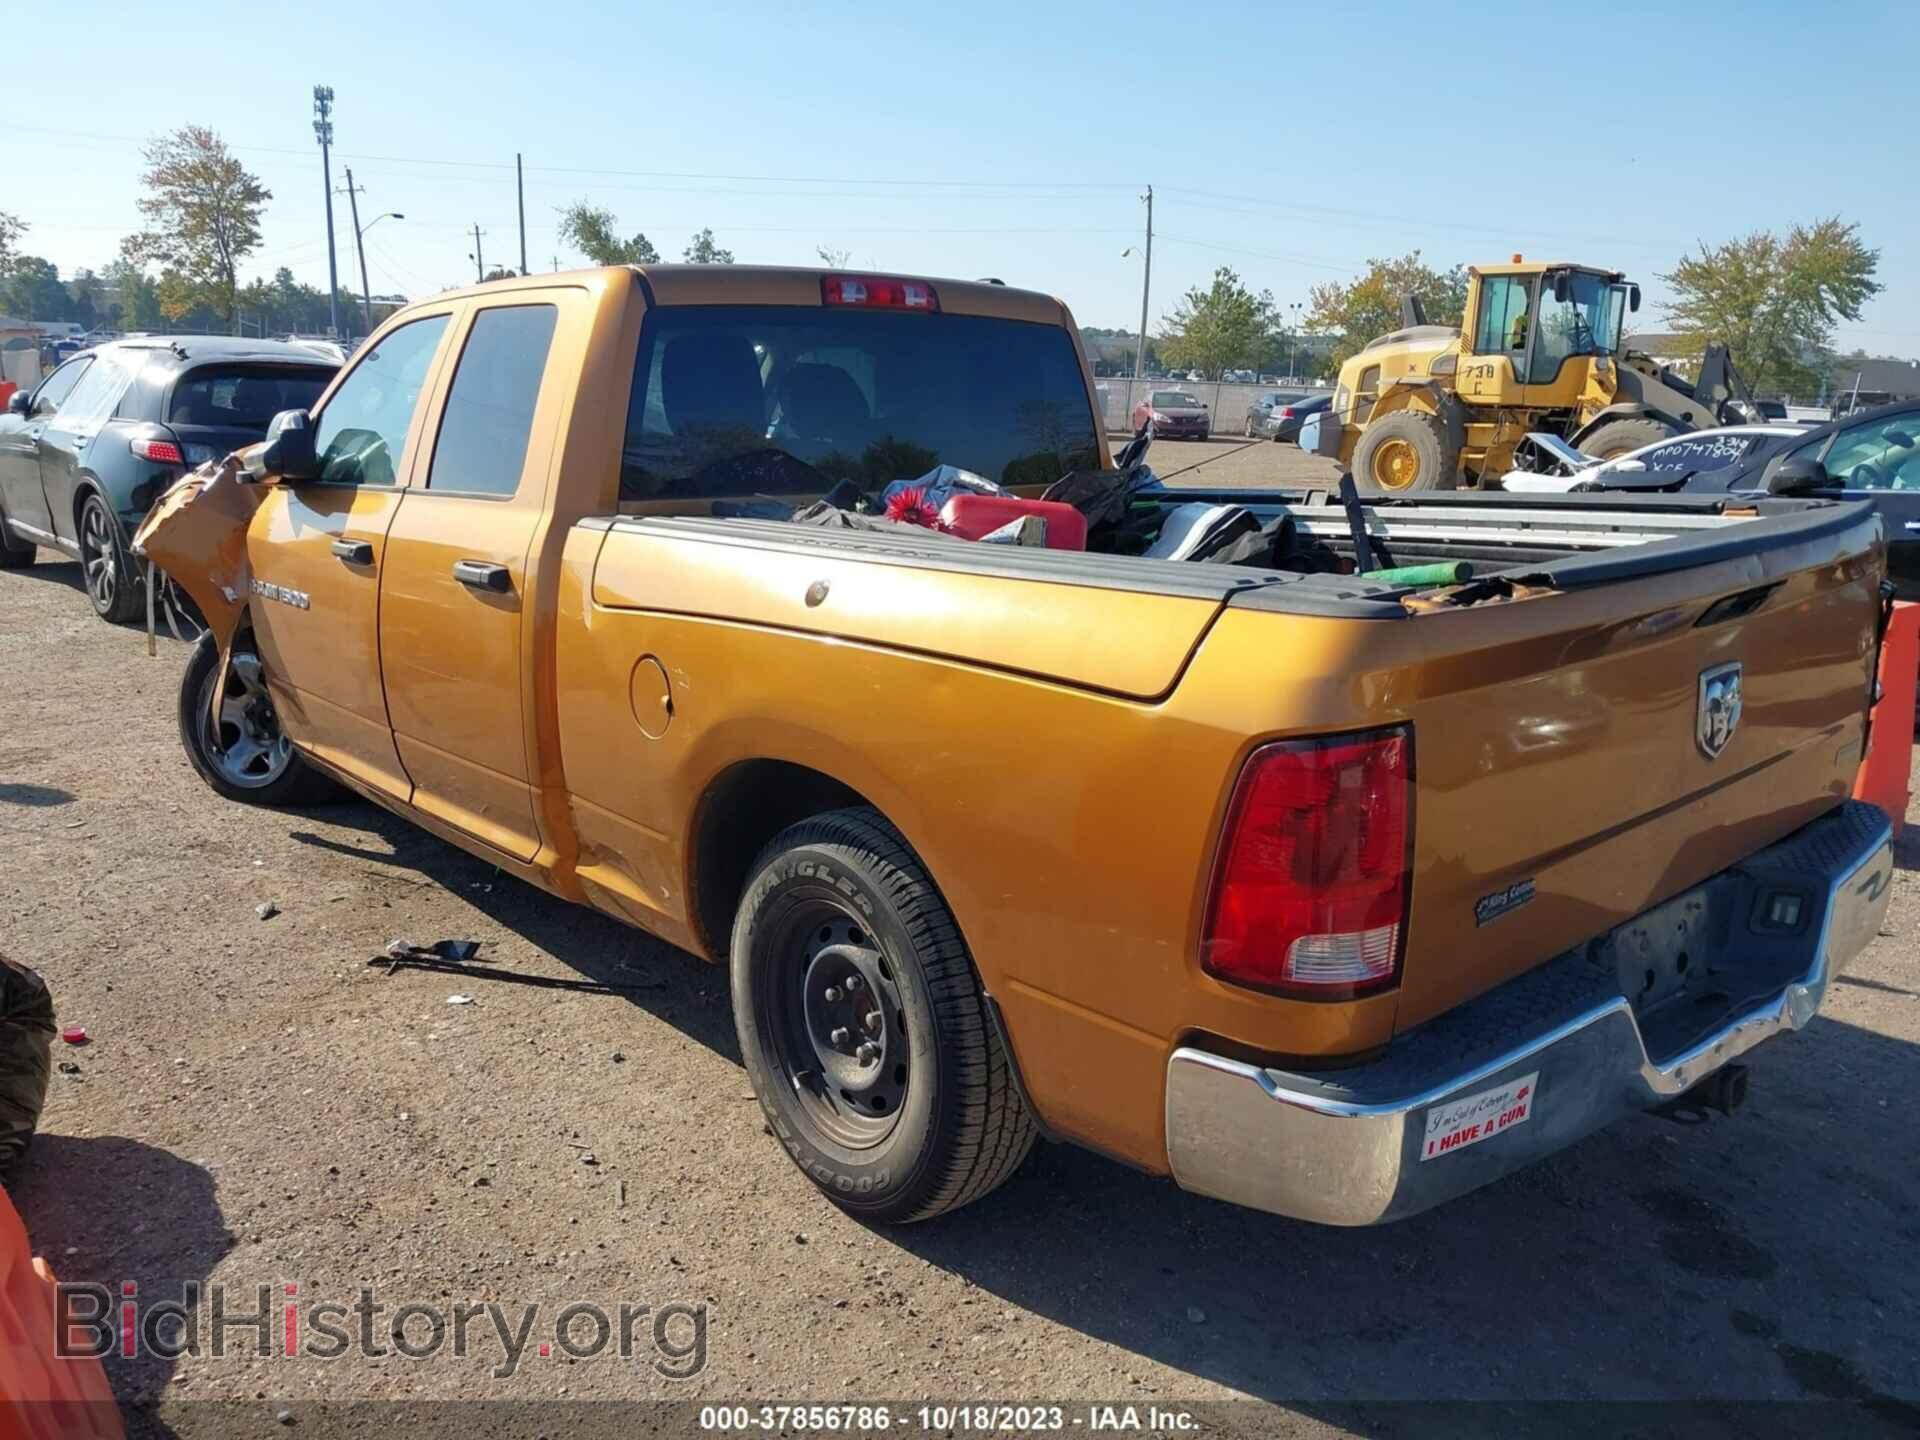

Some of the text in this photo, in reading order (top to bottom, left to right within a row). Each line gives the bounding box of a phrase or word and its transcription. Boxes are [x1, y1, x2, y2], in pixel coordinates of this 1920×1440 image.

[1428, 1141, 1435, 1155] I
[1440, 1124, 1480, 1150] HAVE
[1484, 1119, 1494, 1135] A
[1498, 1104, 1527, 1128] GUN
